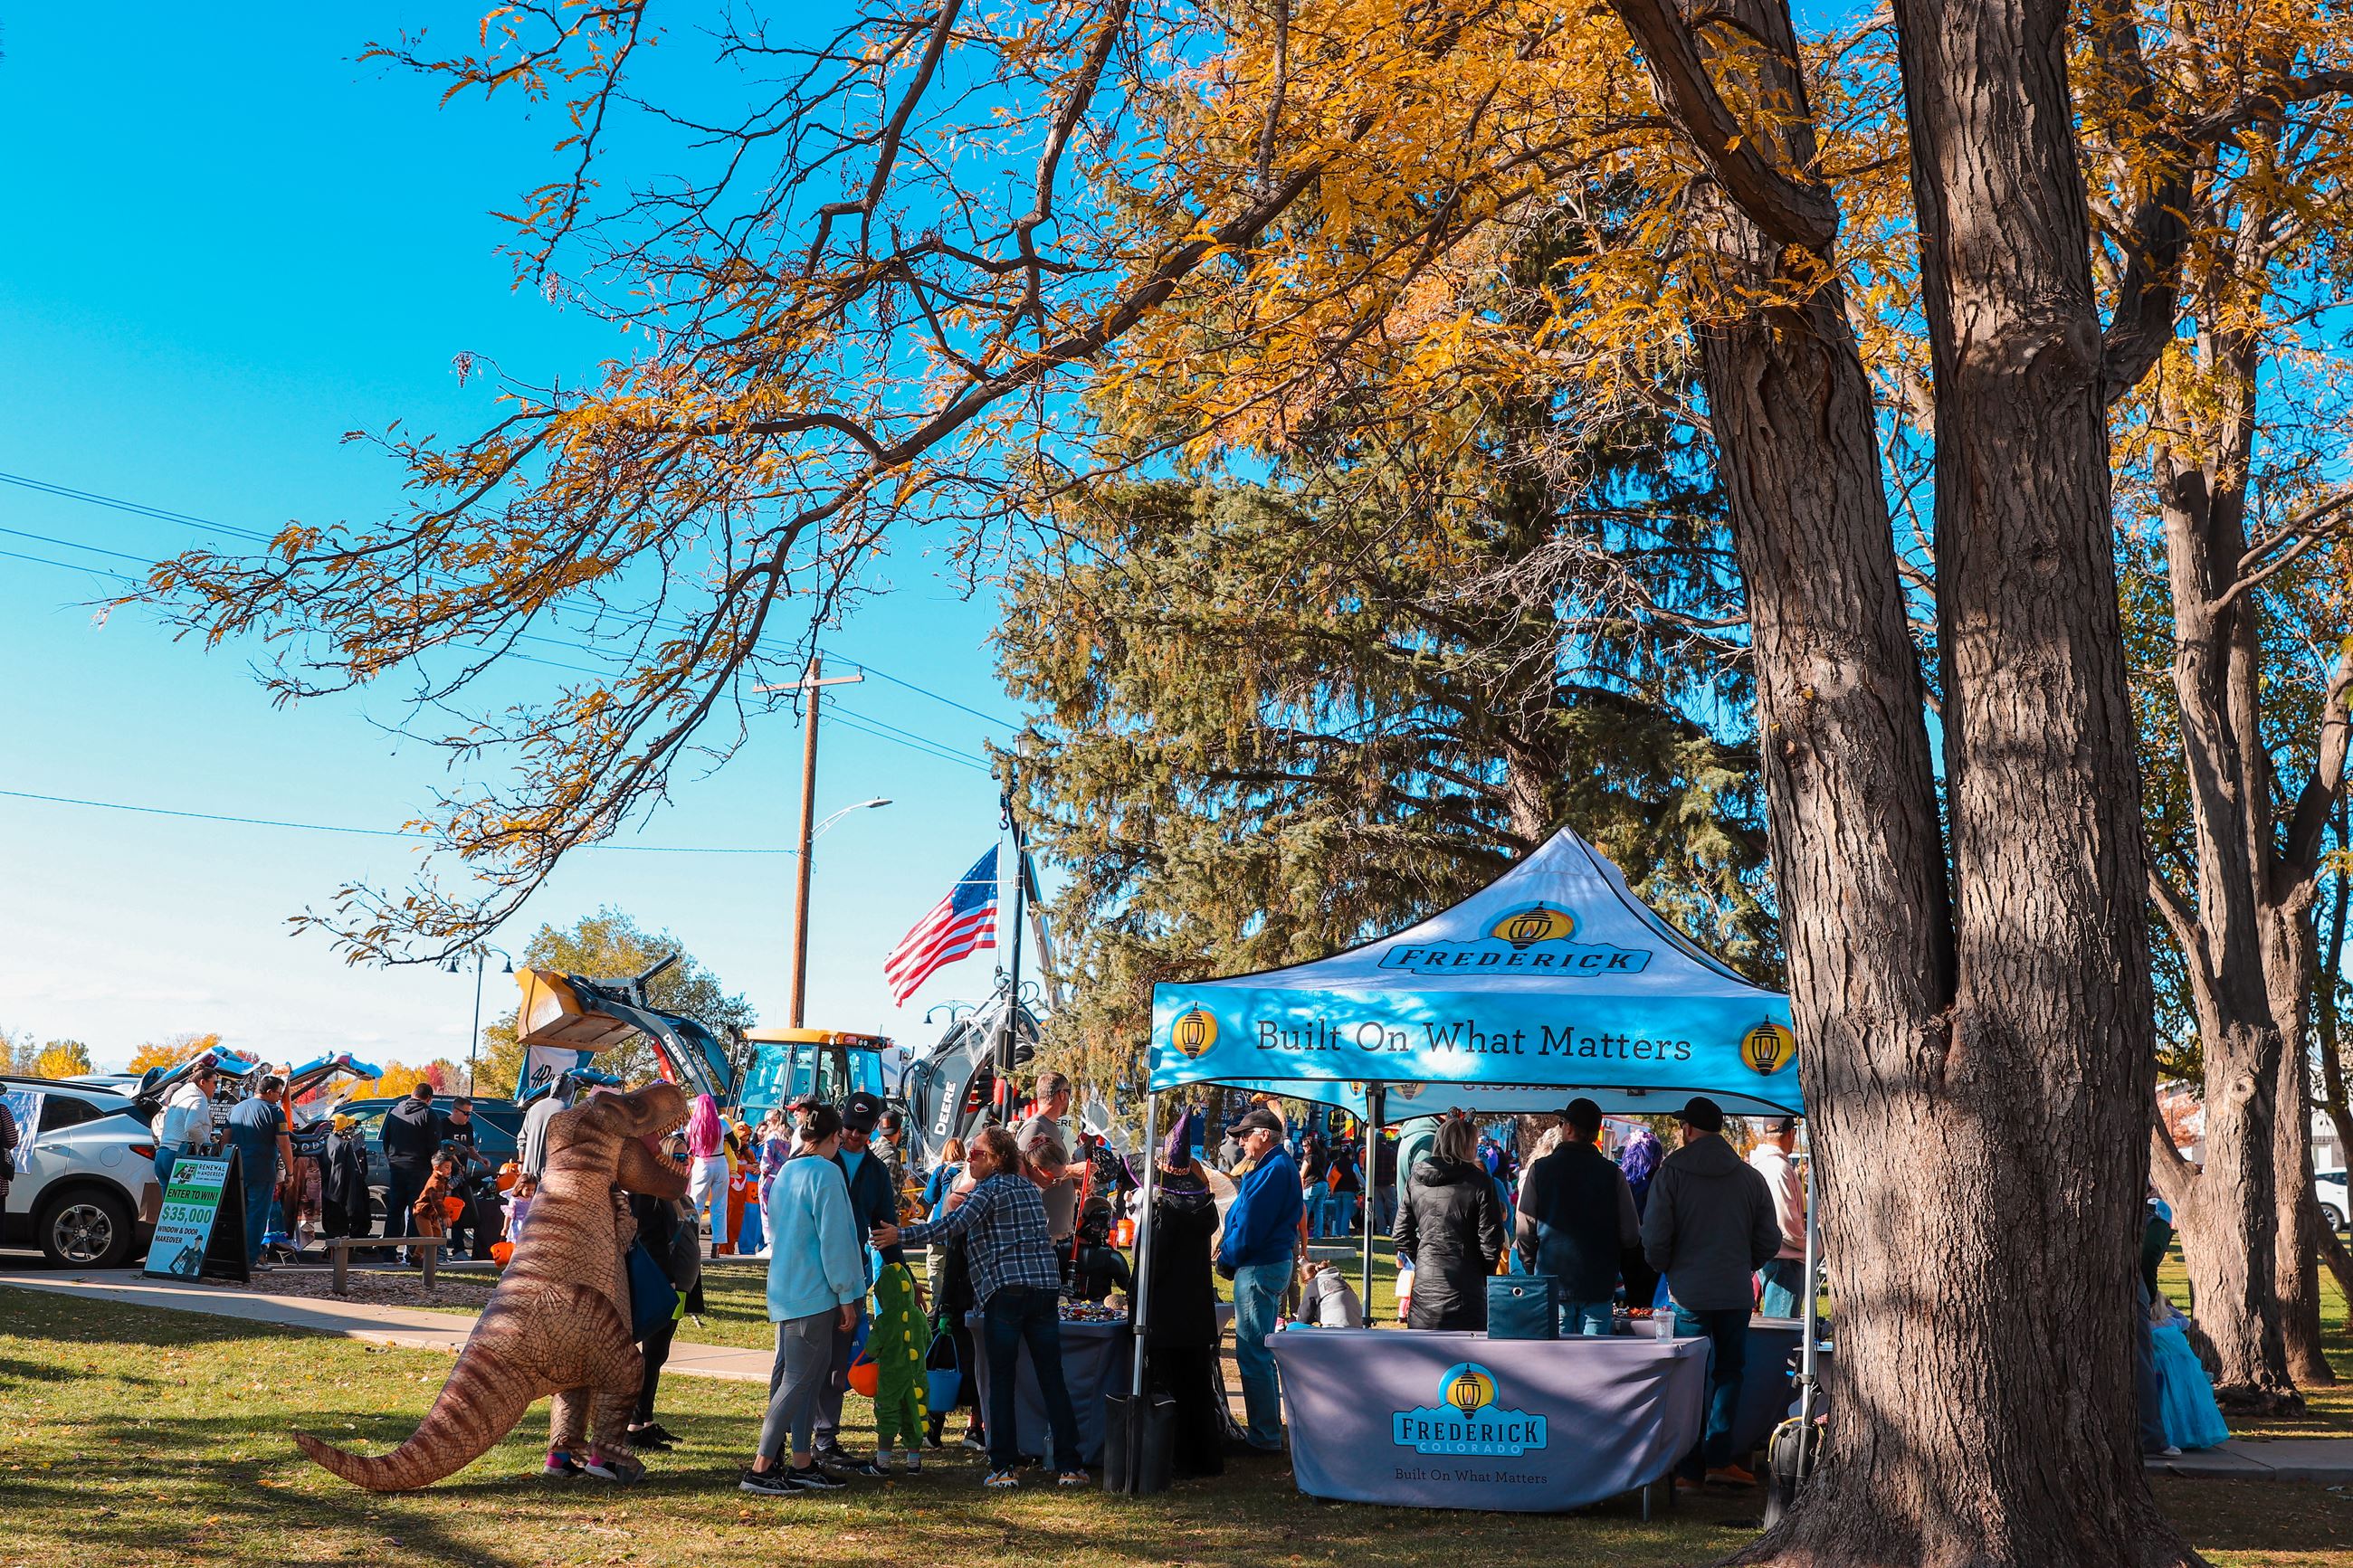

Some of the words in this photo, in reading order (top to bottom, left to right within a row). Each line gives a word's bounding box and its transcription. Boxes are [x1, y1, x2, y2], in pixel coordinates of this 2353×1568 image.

[1396, 949, 1634, 969] FREDERICK
[1422, 966, 1593, 975] COLORADO
[1256, 1018, 1342, 1050] Built
[1357, 1021, 1409, 1051] On
[1423, 1019, 1526, 1055] What
[1538, 1025, 1691, 1060] Matters
[662, 1032, 686, 1065] DEERE
[934, 1081, 957, 1136] DEERE
[198, 1164, 225, 1172] RENEWAL
[167, 1188, 190, 1199] ENTER
[191, 1190, 201, 1200] TO
[201, 1191, 218, 1202] WIN!
[161, 1205, 212, 1225] $35,000
[157, 1225, 178, 1235] WINDOW
[184, 1227, 199, 1236] DOOR
[154, 1234, 183, 1244] MAKEOVER
[1402, 1418, 1538, 1442] FREDERICK
[1419, 1442, 1520, 1454] COLORADO
[1395, 1468, 1426, 1480] Built
[1430, 1468, 1450, 1481] On
[1454, 1469, 1491, 1482] What
[1495, 1471, 1548, 1484] Matters
